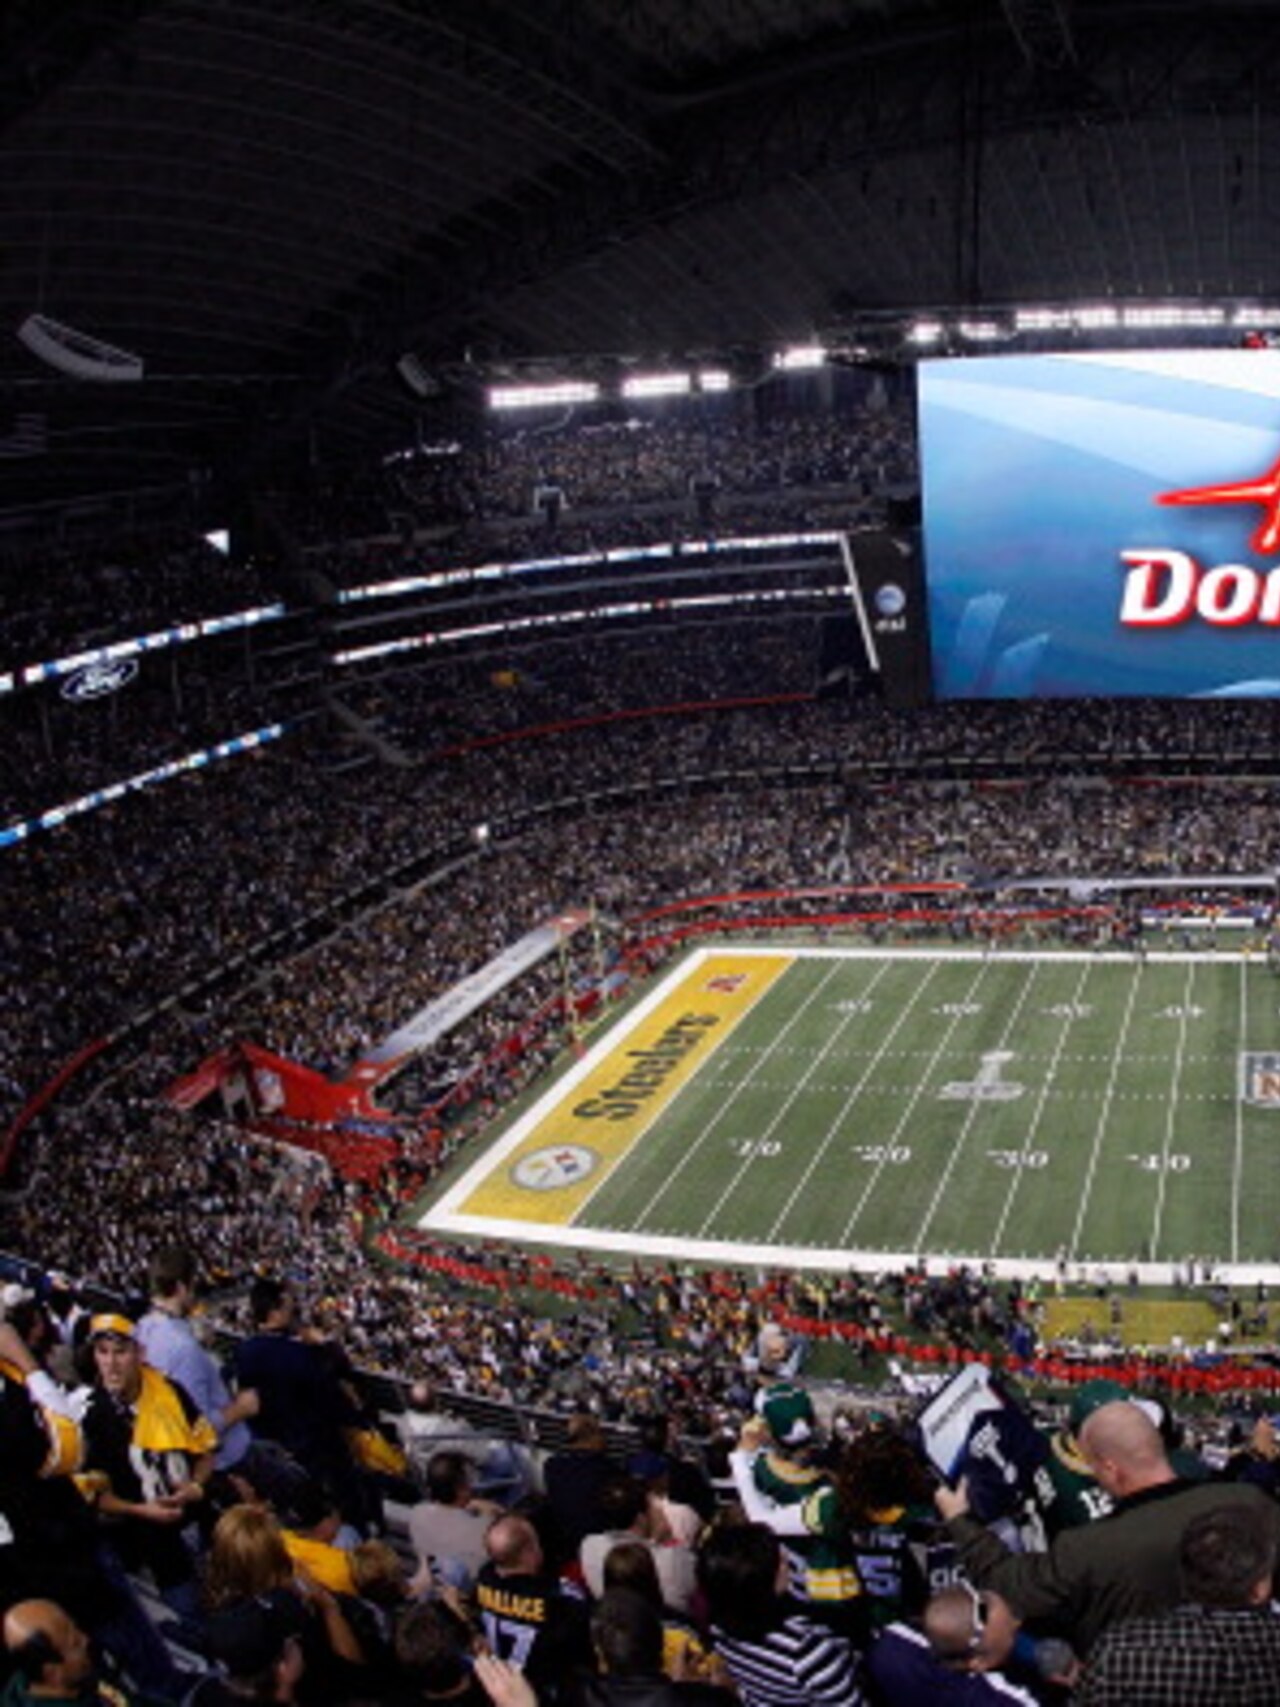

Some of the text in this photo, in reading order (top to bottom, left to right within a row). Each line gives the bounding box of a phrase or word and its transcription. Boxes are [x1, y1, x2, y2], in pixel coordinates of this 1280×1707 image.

[572, 1011, 721, 1121] Steelers
[1140, 1154, 1192, 1172] 40
[477, 1583, 546, 1623] WALLACE
